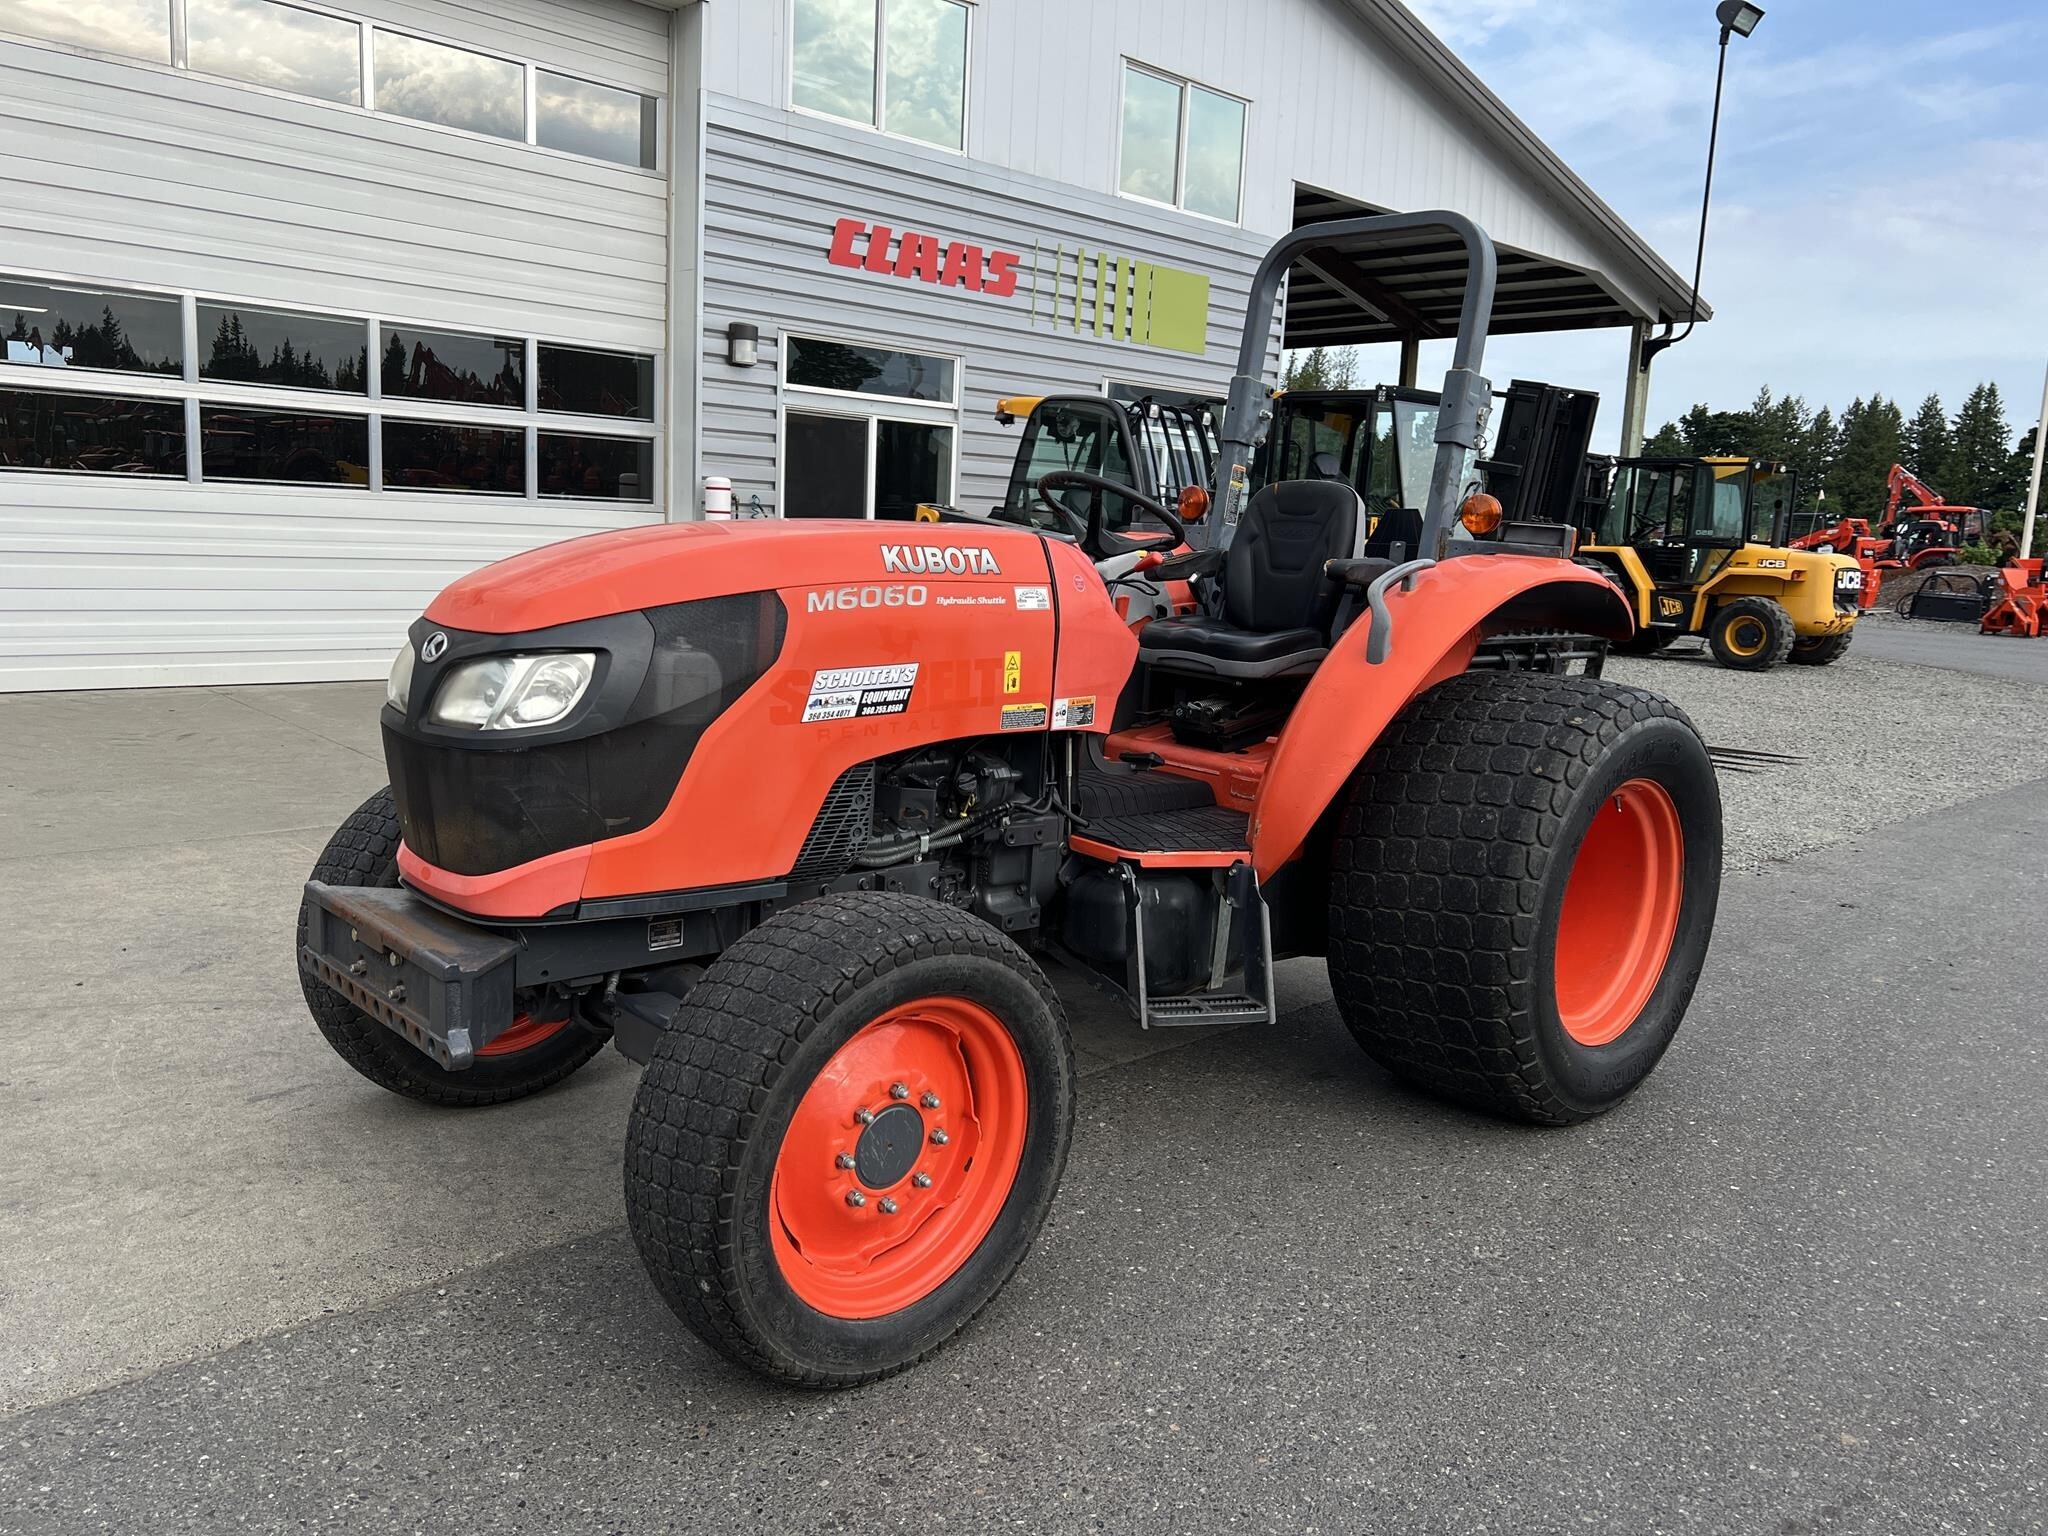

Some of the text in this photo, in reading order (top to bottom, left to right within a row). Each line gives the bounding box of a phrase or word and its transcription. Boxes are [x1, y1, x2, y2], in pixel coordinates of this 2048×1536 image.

[828, 217, 1021, 298] CLAAS
[880, 544, 1001, 576] KUBOTA
[1757, 558, 1786, 568] JCB
[1837, 571, 1861, 589] JCB
[807, 585, 928, 613] M6060
[936, 596, 976, 606] Hydraulic
[977, 596, 1007, 605] Shuttle
[1663, 599, 1682, 615] JCB
[814, 667, 915, 690] SCHOLTEN'S
[861, 688, 911, 704] EQUIPMENT
